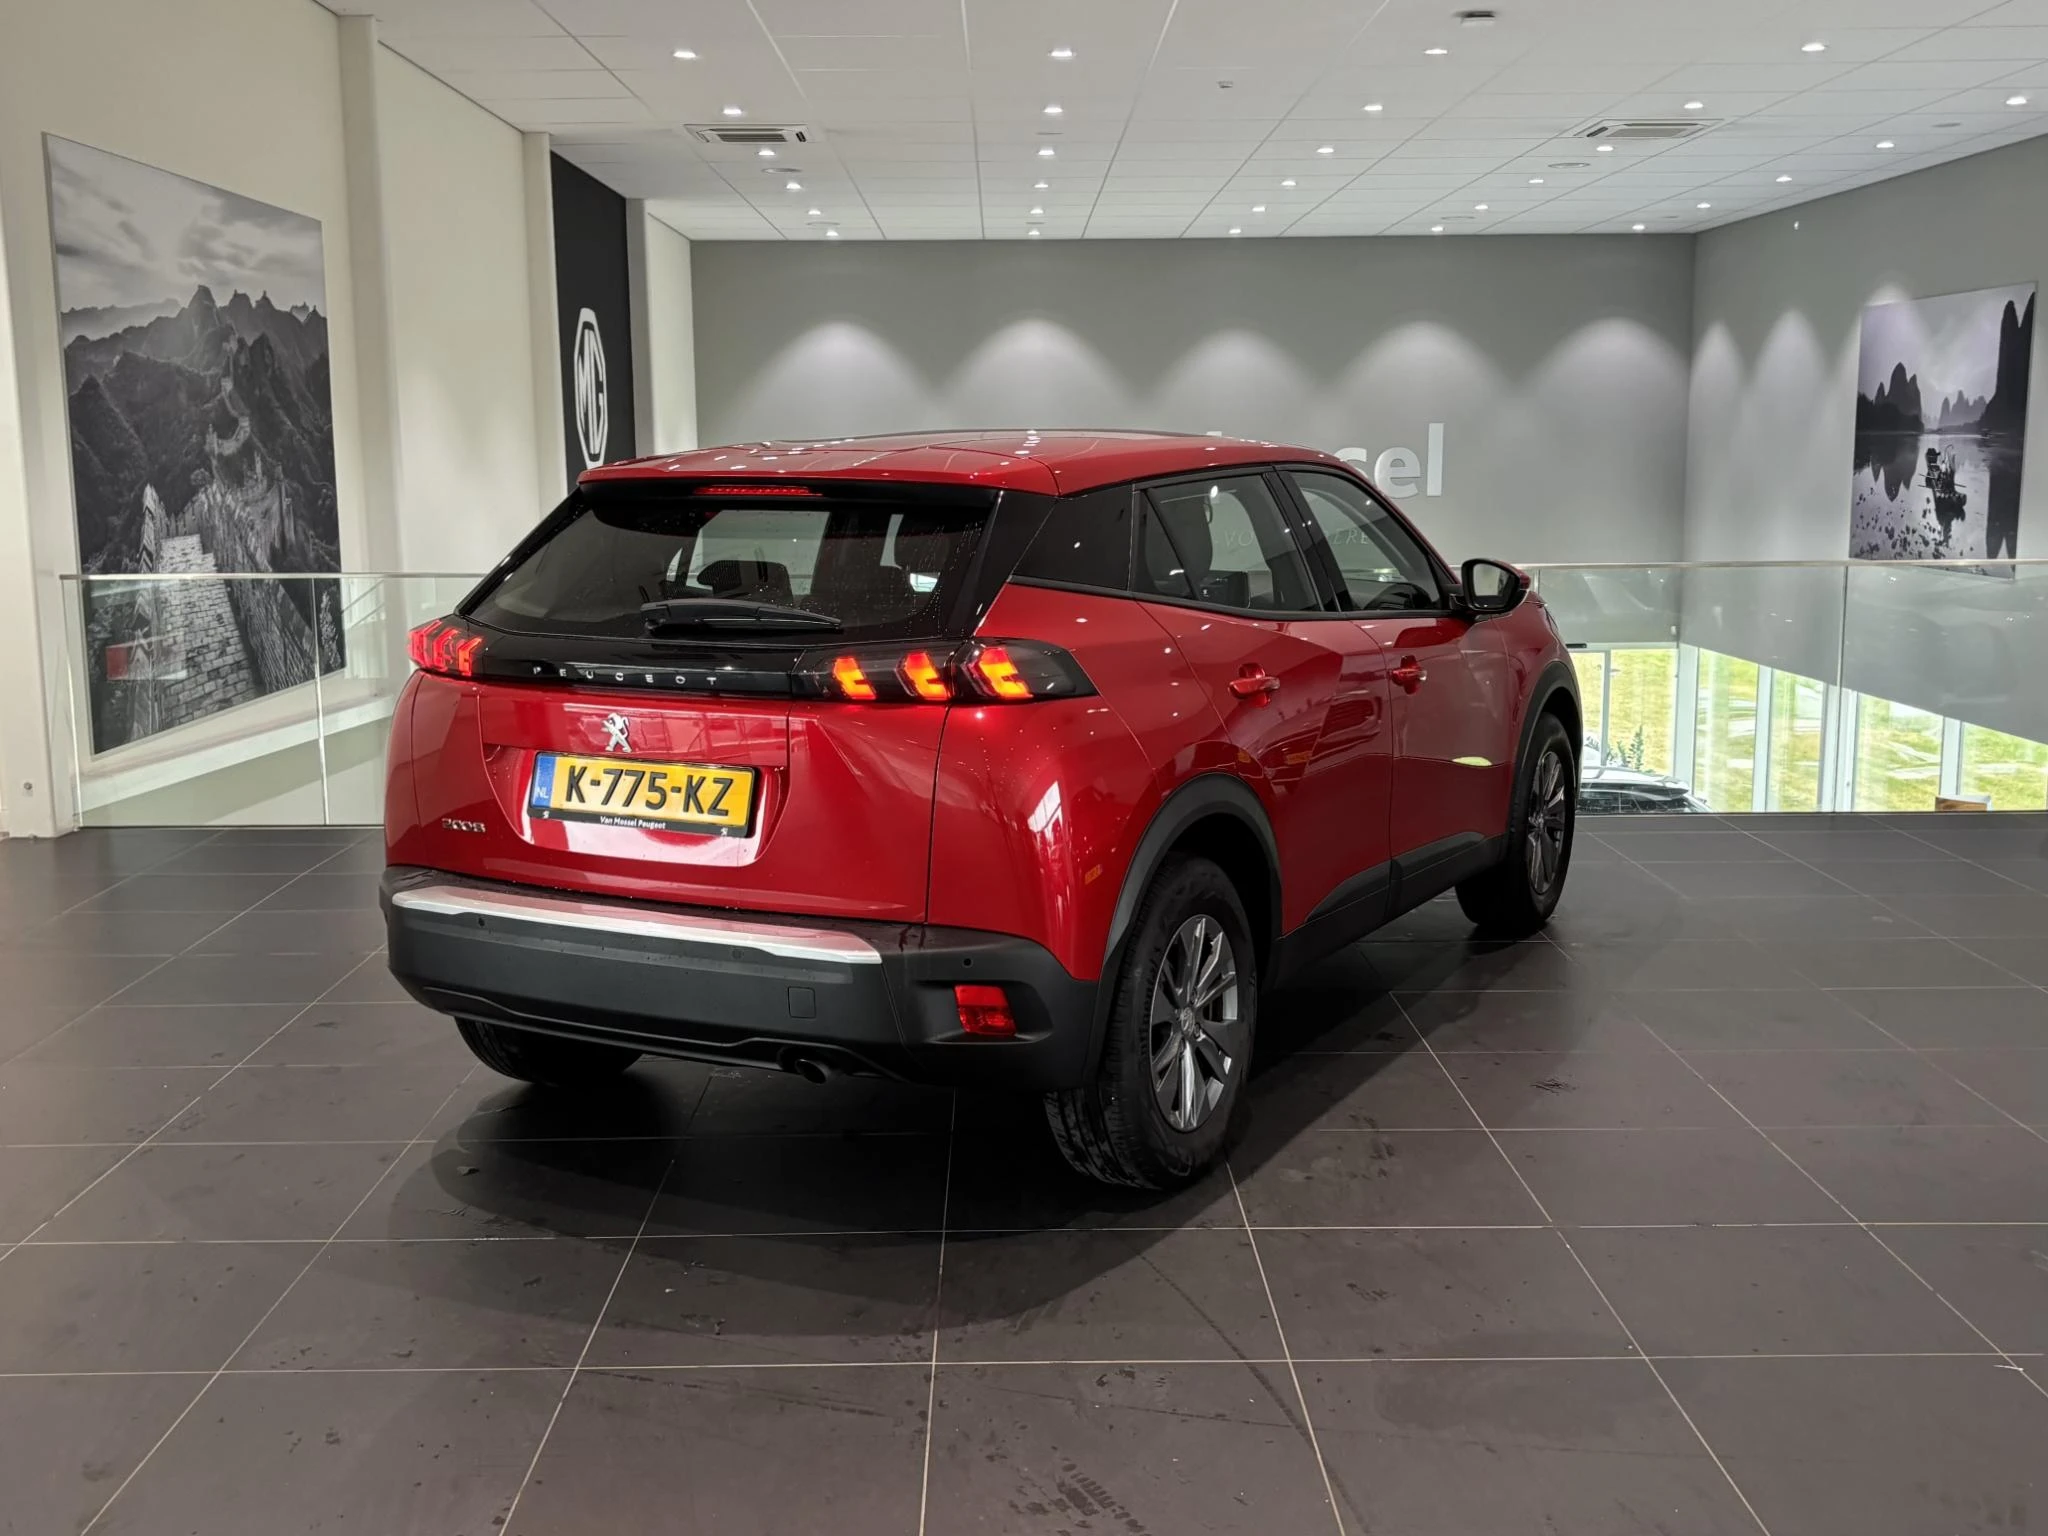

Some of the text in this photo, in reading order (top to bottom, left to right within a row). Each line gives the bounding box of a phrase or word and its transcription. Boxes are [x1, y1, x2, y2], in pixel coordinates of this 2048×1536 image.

[533, 666, 717, 685] PEUGEOT
[534, 785, 549, 799] NL
[565, 765, 734, 816] K-775-KZ
[441, 818, 486, 833] 2008
[600, 816, 666, 829] Van Mossel Peugeot
